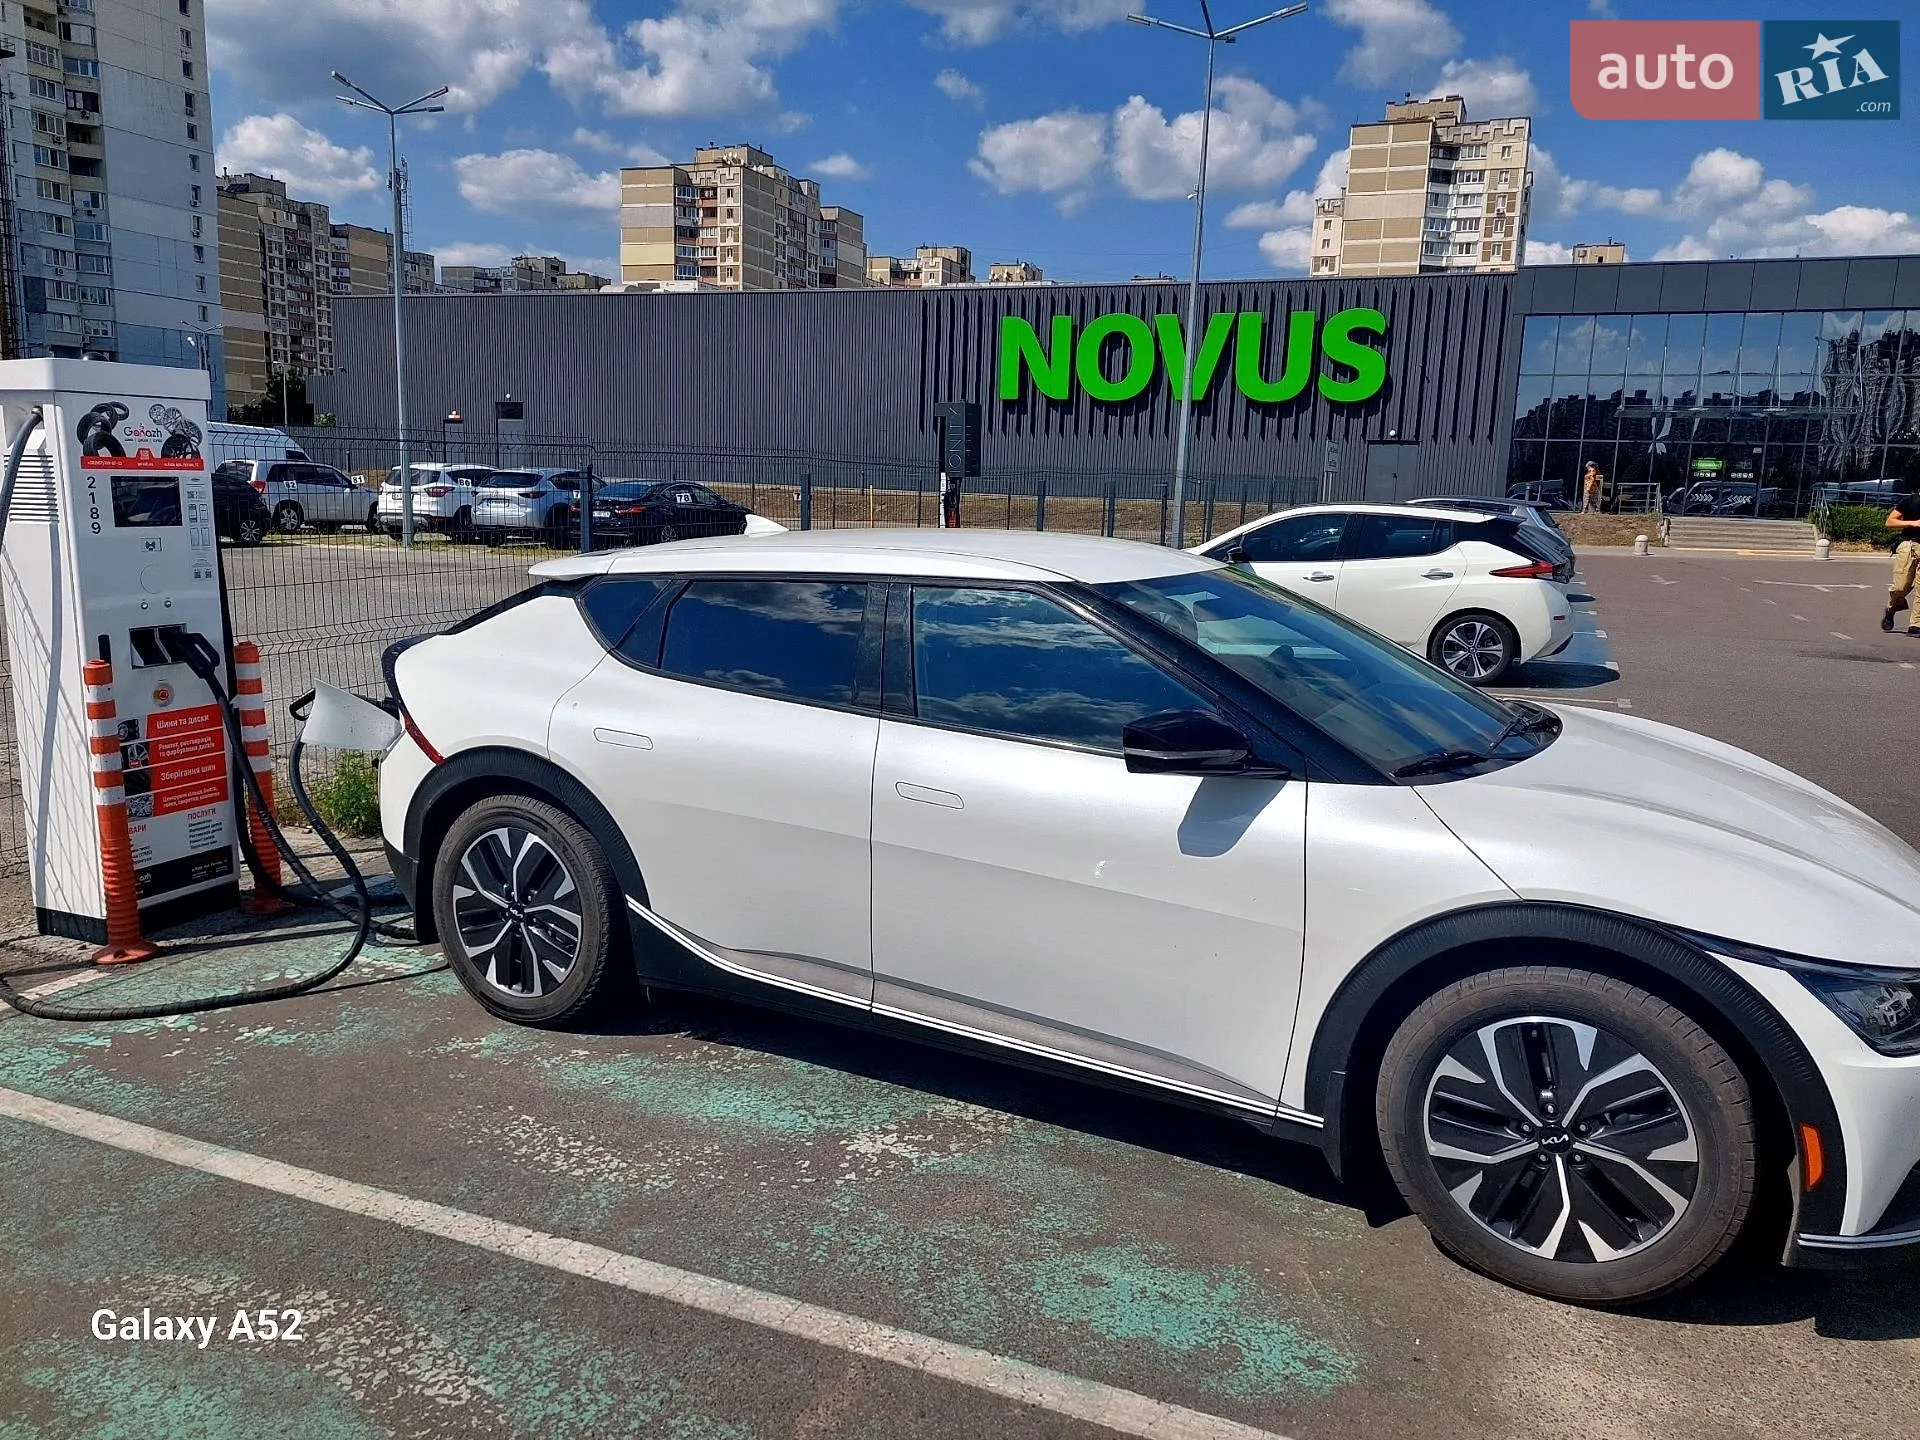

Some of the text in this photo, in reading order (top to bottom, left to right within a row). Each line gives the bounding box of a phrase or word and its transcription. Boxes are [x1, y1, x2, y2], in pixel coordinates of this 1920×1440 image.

[1000, 307, 1388, 402] NOVUS
[156, 719, 178, 729] Шини
[188, 715, 210, 726] диски
[161, 764, 216, 781] Зберігання шин
[188, 807, 217, 820] ПОСЛУГИ
[128, 823, 147, 835] ВАРИ
